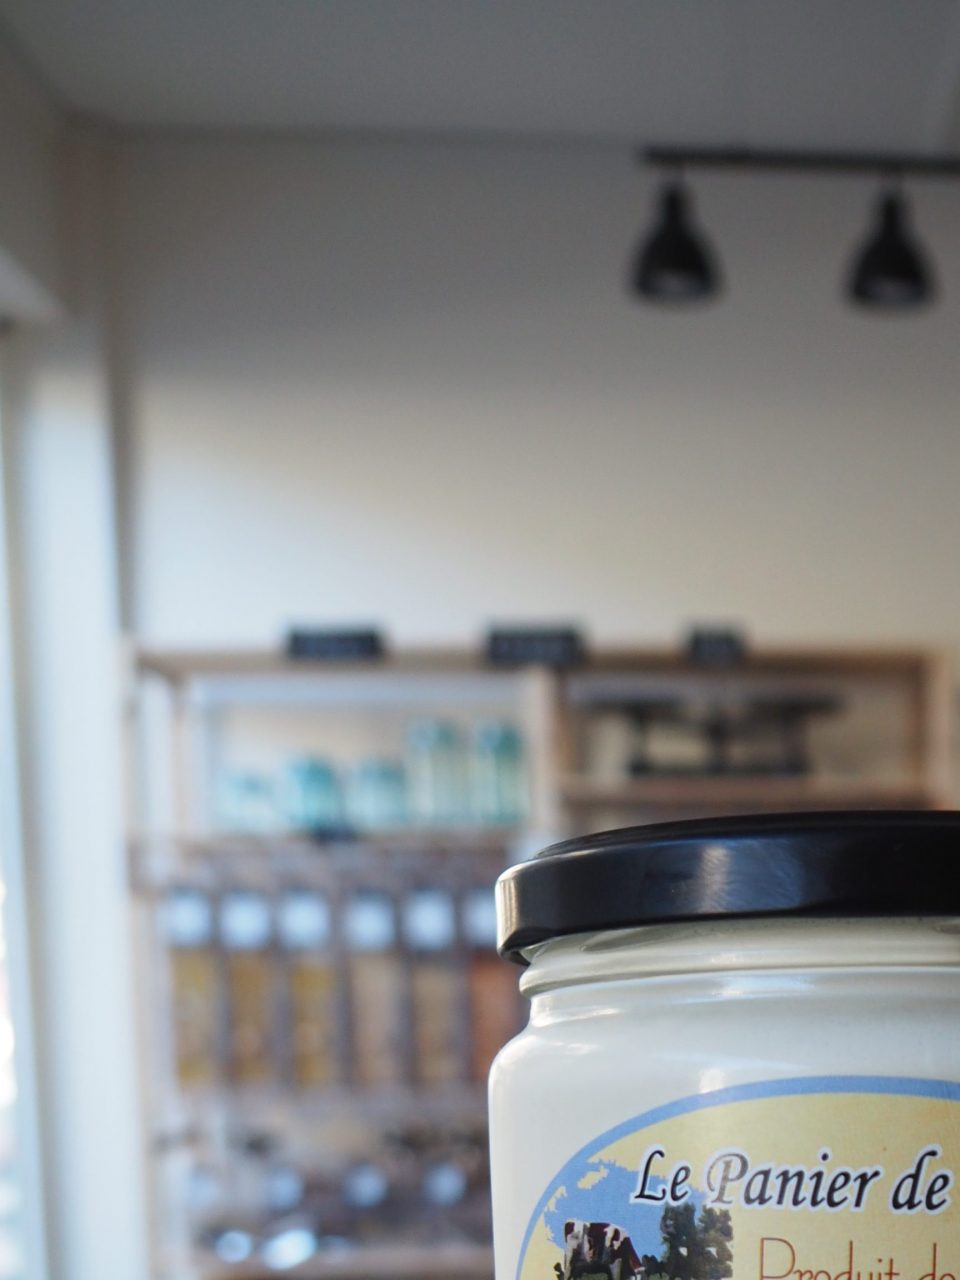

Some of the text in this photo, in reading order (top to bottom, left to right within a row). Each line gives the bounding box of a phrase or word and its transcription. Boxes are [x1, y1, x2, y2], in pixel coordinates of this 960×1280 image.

[634, 1149, 691, 1202] Le
[705, 1151, 880, 1210] Panier
[891, 1150, 949, 1211] de
